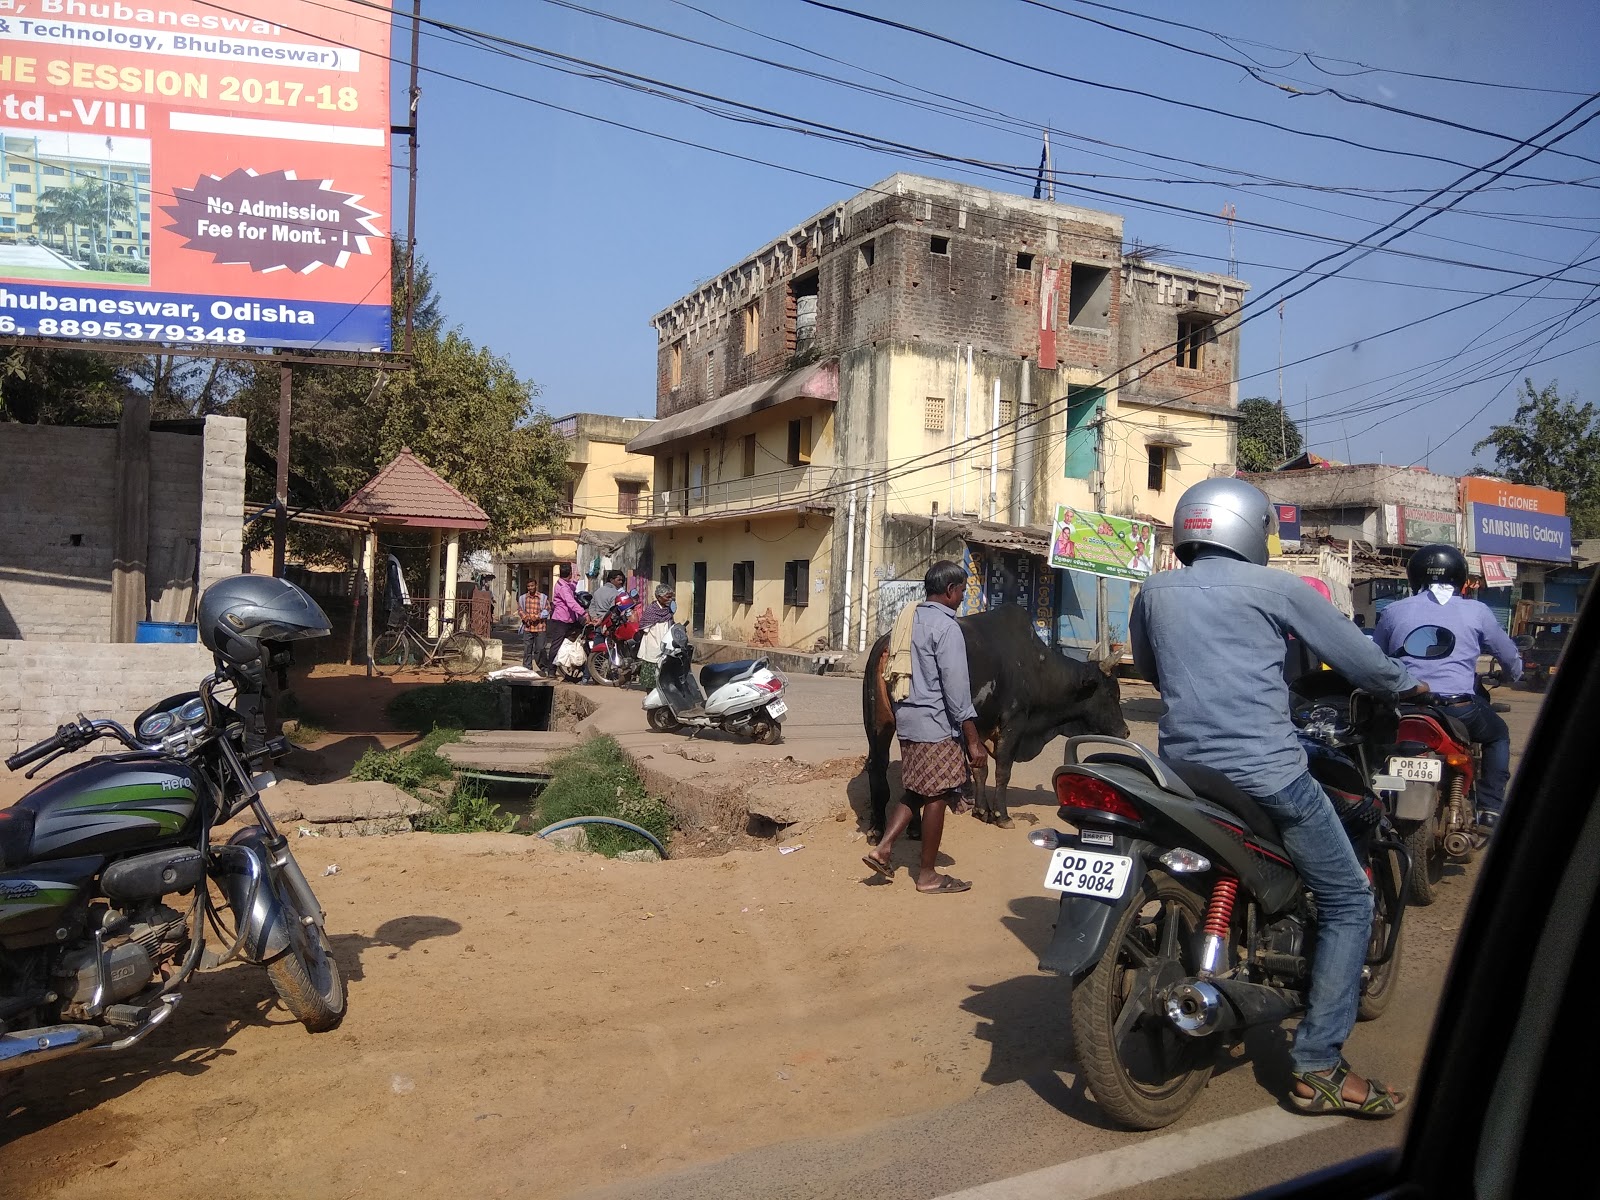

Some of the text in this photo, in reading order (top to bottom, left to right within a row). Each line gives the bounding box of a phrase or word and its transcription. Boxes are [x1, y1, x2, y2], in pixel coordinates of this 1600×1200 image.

[42, 0, 287, 36] Bhubaneswar
[20, 20, 163, 50] Technology,
[173, 35, 340, 67] Bhubaneswar)
[46, 60, 208, 99] SESSION
[219, 76, 359, 112] 2017-18
[0, 93, 146, 130] td.-VIII
[207, 196, 340, 223] No Admission
[197, 219, 233, 238] Fee
[237, 221, 267, 240] for
[272, 224, 327, 245] Mont.
[0, 289, 315, 325] hubaneswar, Odisha
[0, 316, 246, 344] 6, 8895379348
[1508, 495, 1539, 512] GIONEE
[1482, 517, 1564, 549] SAMSUNG Galaxy
[1400, 760, 1428, 770] OR 13
[1407, 769, 1433, 779] 0496
[1062, 856, 1114, 875] OD 02
[1052, 870, 1115, 892] AC 9084
